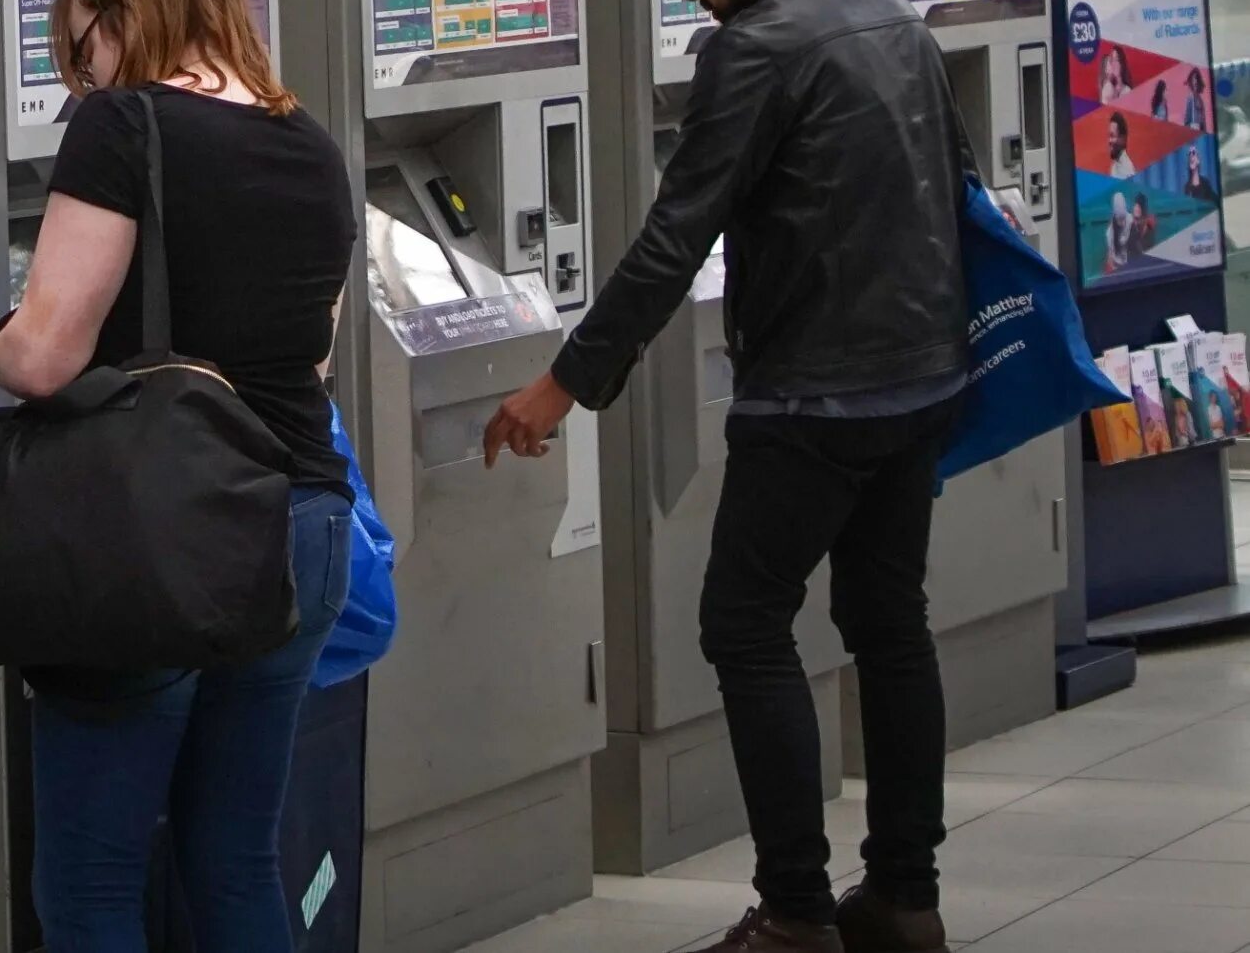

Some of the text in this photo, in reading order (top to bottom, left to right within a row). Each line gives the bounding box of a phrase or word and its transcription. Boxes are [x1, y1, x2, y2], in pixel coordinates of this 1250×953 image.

[1072, 21, 1097, 43] £30
[528, 249, 543, 262] Cards
[979, 293, 1033, 323] Matthey
